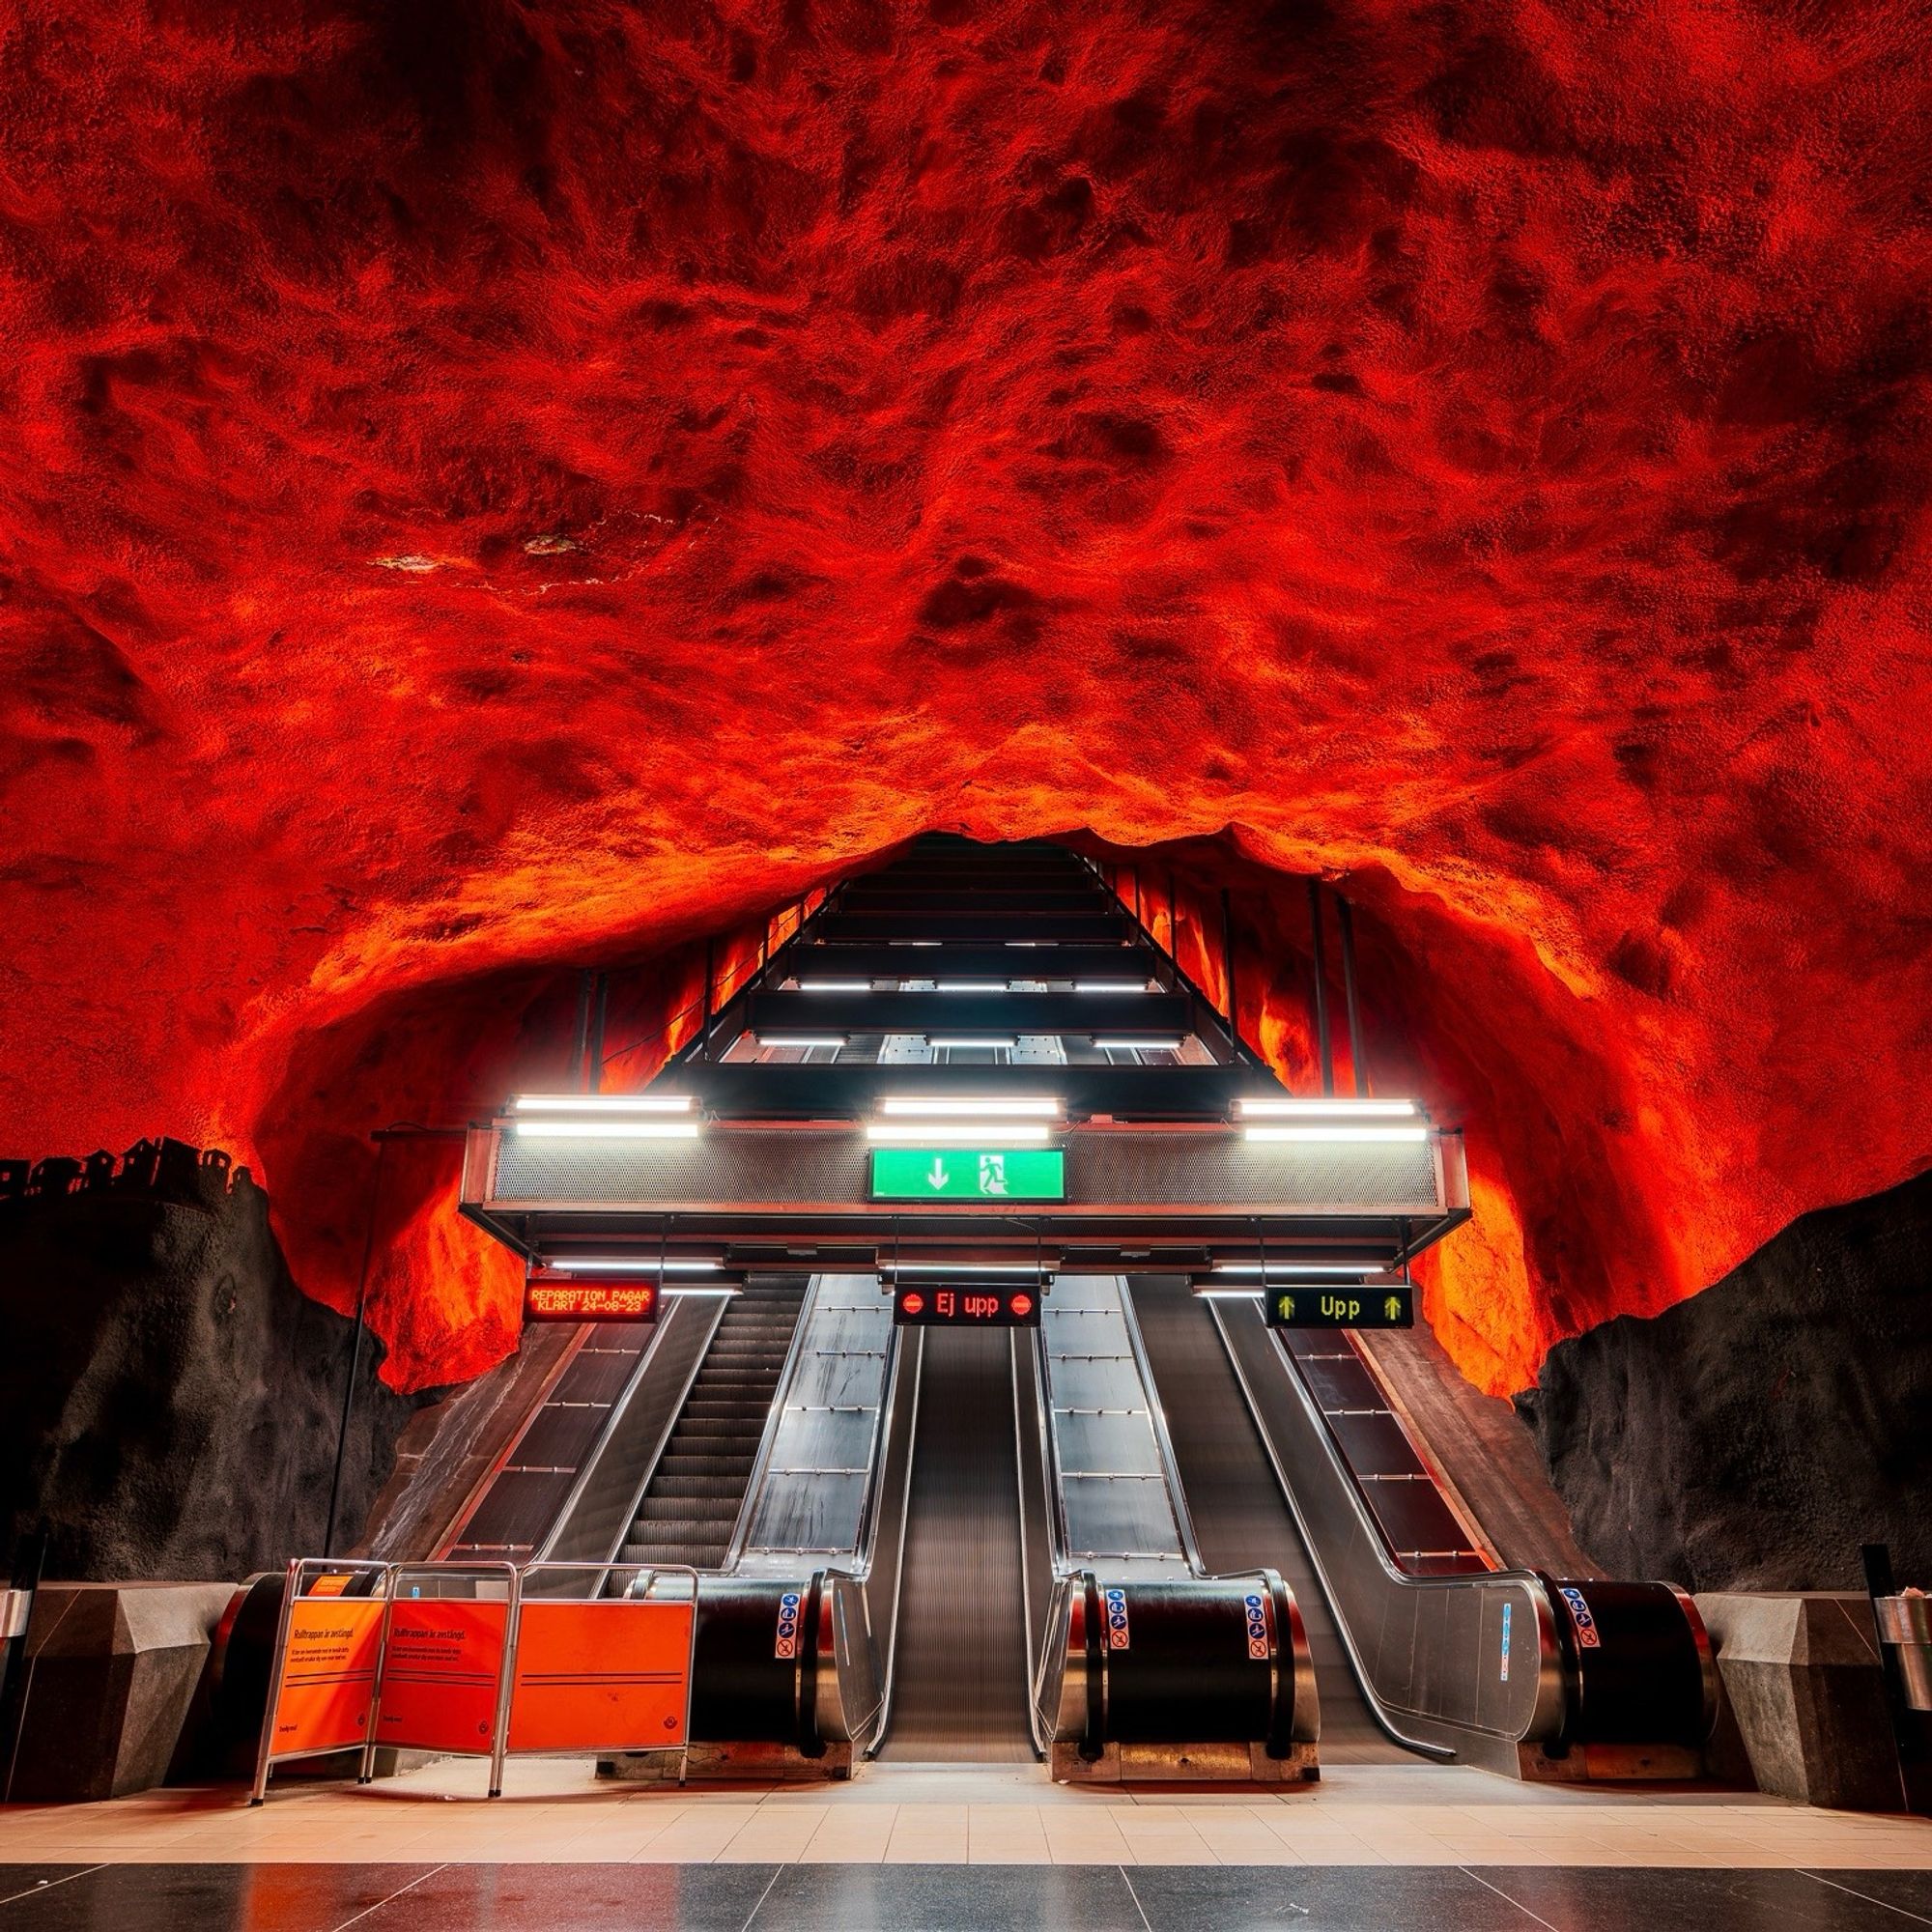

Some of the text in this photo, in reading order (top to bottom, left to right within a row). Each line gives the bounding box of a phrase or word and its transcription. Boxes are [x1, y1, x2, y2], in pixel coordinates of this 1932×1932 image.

[531, 1290, 606, 1300] REPARATION
[537, 1300, 641, 1312] KLART 24-08-23
[937, 1293, 999, 1318] Ej upp
[1321, 1295, 1360, 1320] Upp
